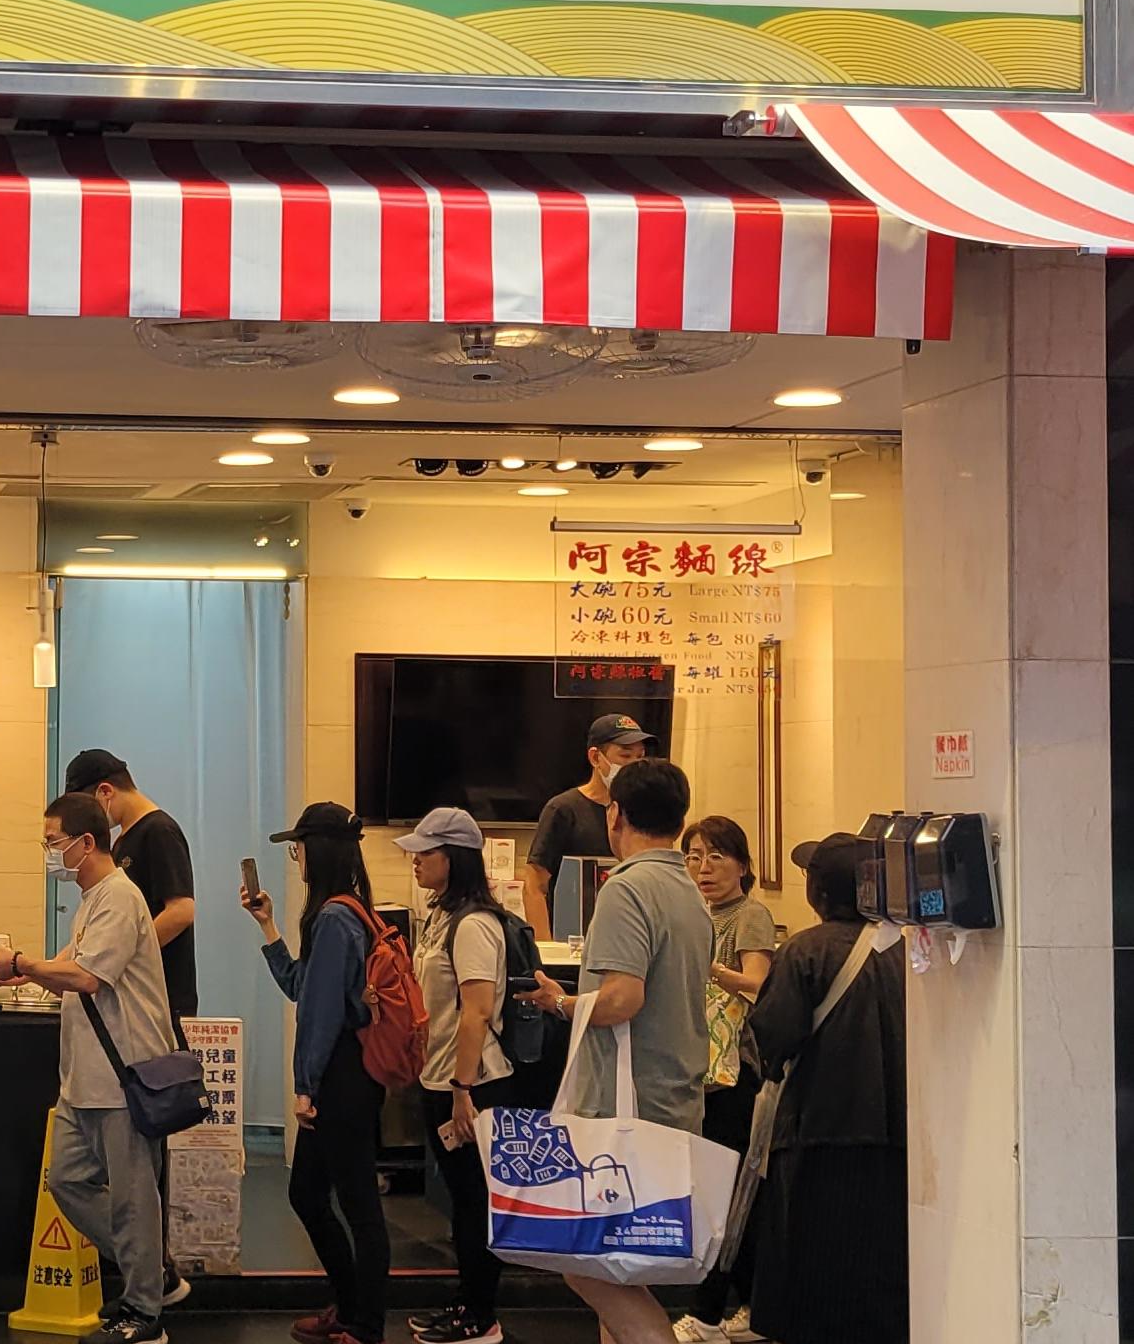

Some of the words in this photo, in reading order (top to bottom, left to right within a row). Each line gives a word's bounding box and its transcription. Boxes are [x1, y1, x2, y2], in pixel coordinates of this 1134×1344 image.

[568, 540, 775, 578] 阿宗麵線
[689, 584, 729, 600] Large
[731, 585, 781, 599] NT$75
[570, 606, 673, 626] 小碗60元
[689, 611, 729, 624] Small
[733, 612, 782, 625] NT$60
[935, 755, 971, 773] Napkin
[34, 1264, 74, 1287] 注意安全
